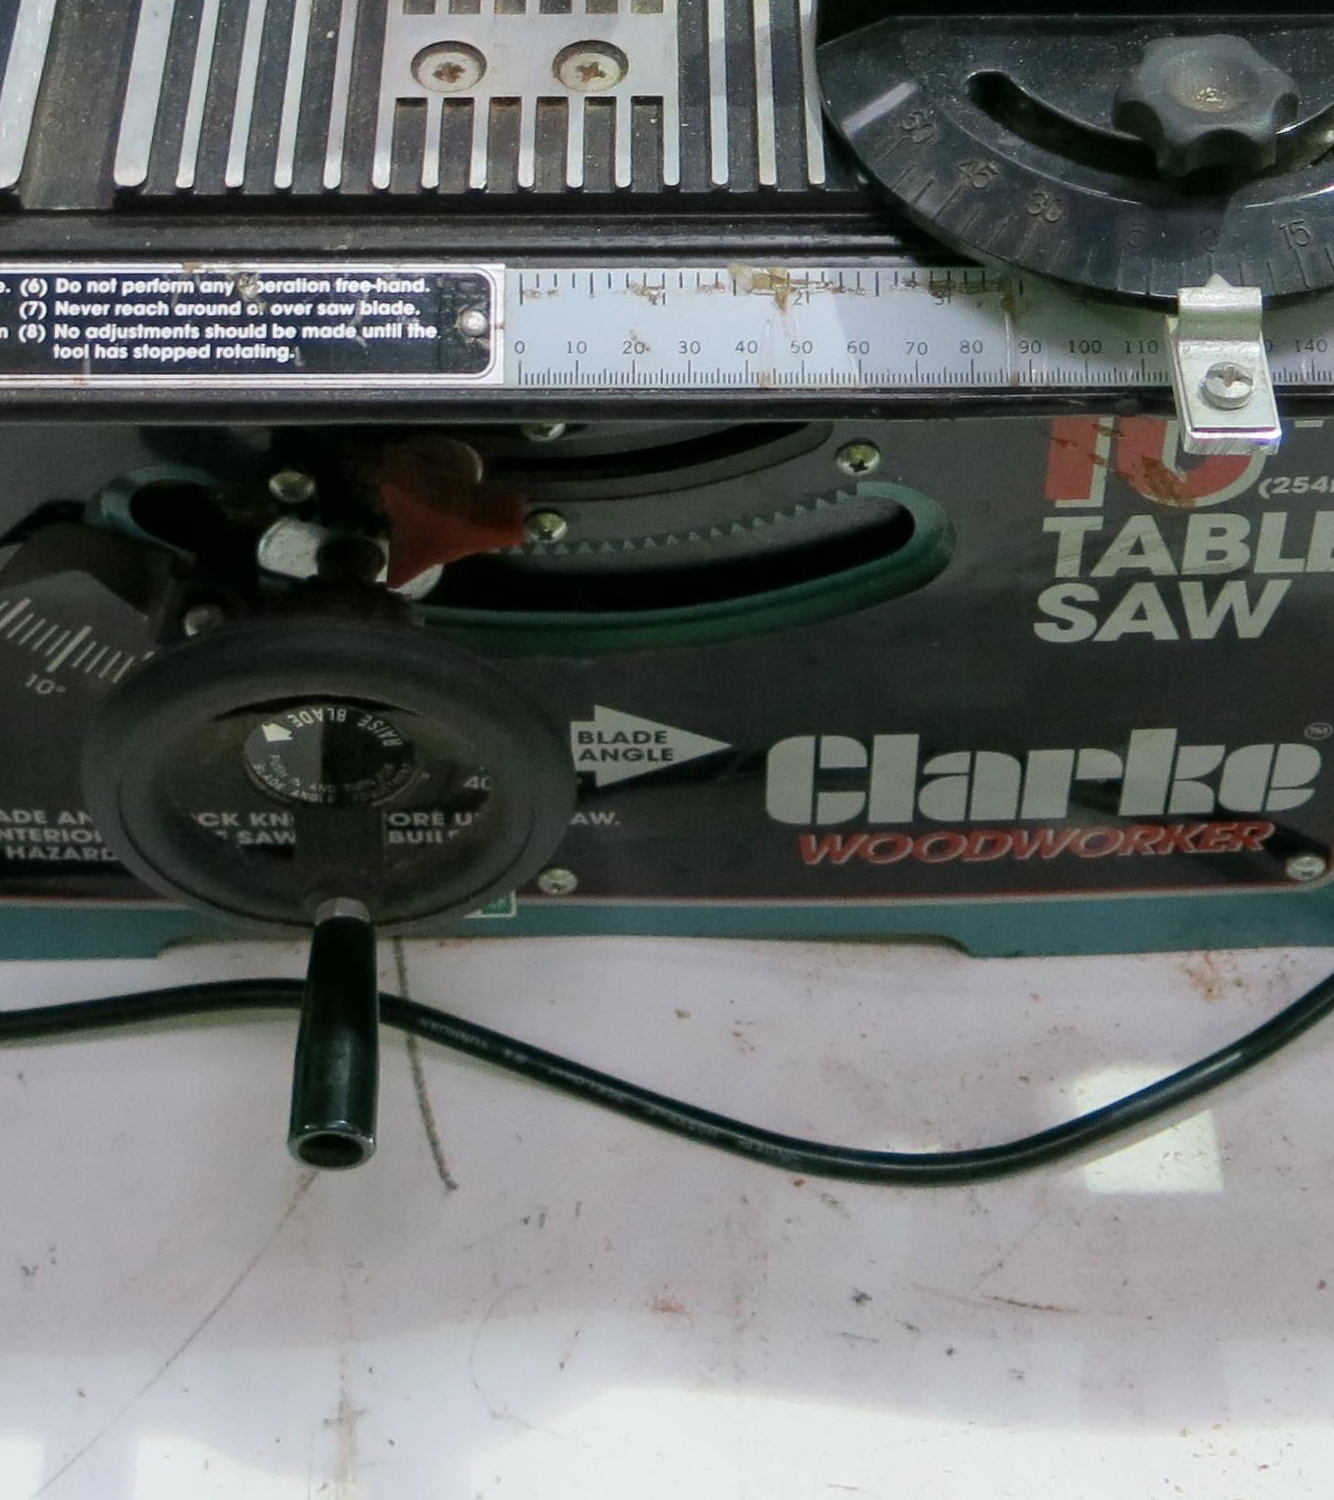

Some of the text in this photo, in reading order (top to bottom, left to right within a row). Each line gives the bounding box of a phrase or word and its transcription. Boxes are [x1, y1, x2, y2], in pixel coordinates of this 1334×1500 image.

[20, 278, 48, 298] (6)
[56, 278, 82, 293] Do
[87, 278, 117, 294] not
[122, 278, 194, 298] perform
[199, 280, 235, 297] any
[336, 278, 431, 294] free-hand.
[19, 301, 47, 320] (7)
[55, 301, 110, 316] Never
[115, 300, 169, 316] reach
[174, 300, 242, 316] around
[270, 303, 313, 316] over
[317, 303, 356, 316] saw
[360, 300, 421, 316] blade.
[18, 324, 47, 344] (8)
[54, 323, 80, 339] No
[85, 323, 200, 343] adjustments
[205, 323, 267, 339] should
[272, 323, 297, 339] be
[302, 323, 357, 339] made
[362, 323, 402, 339] until
[53, 344, 295, 363] tool has stopped rotating.
[566, 340, 588, 355] 10
[623, 340, 645, 355] 20
[679, 340, 701, 355] 30
[735, 340, 758, 355] 40
[790, 340, 813, 355] 50
[847, 340, 870, 354] 60
[906, 340, 929, 355] 70
[960, 340, 984, 354] 80
[1019, 339, 1042, 354] 90
[1069, 339, 1103, 354] 100
[1125, 339, 1158, 354] 110
[1294, 339, 1328, 354] 140
[1034, 581, 1279, 642] SAW
[578, 729, 669, 747] BLADE
[578, 747, 674, 764] ANGLE
[765, 728, 1323, 827] Clarke
[799, 821, 1276, 866] WOODWORKER
